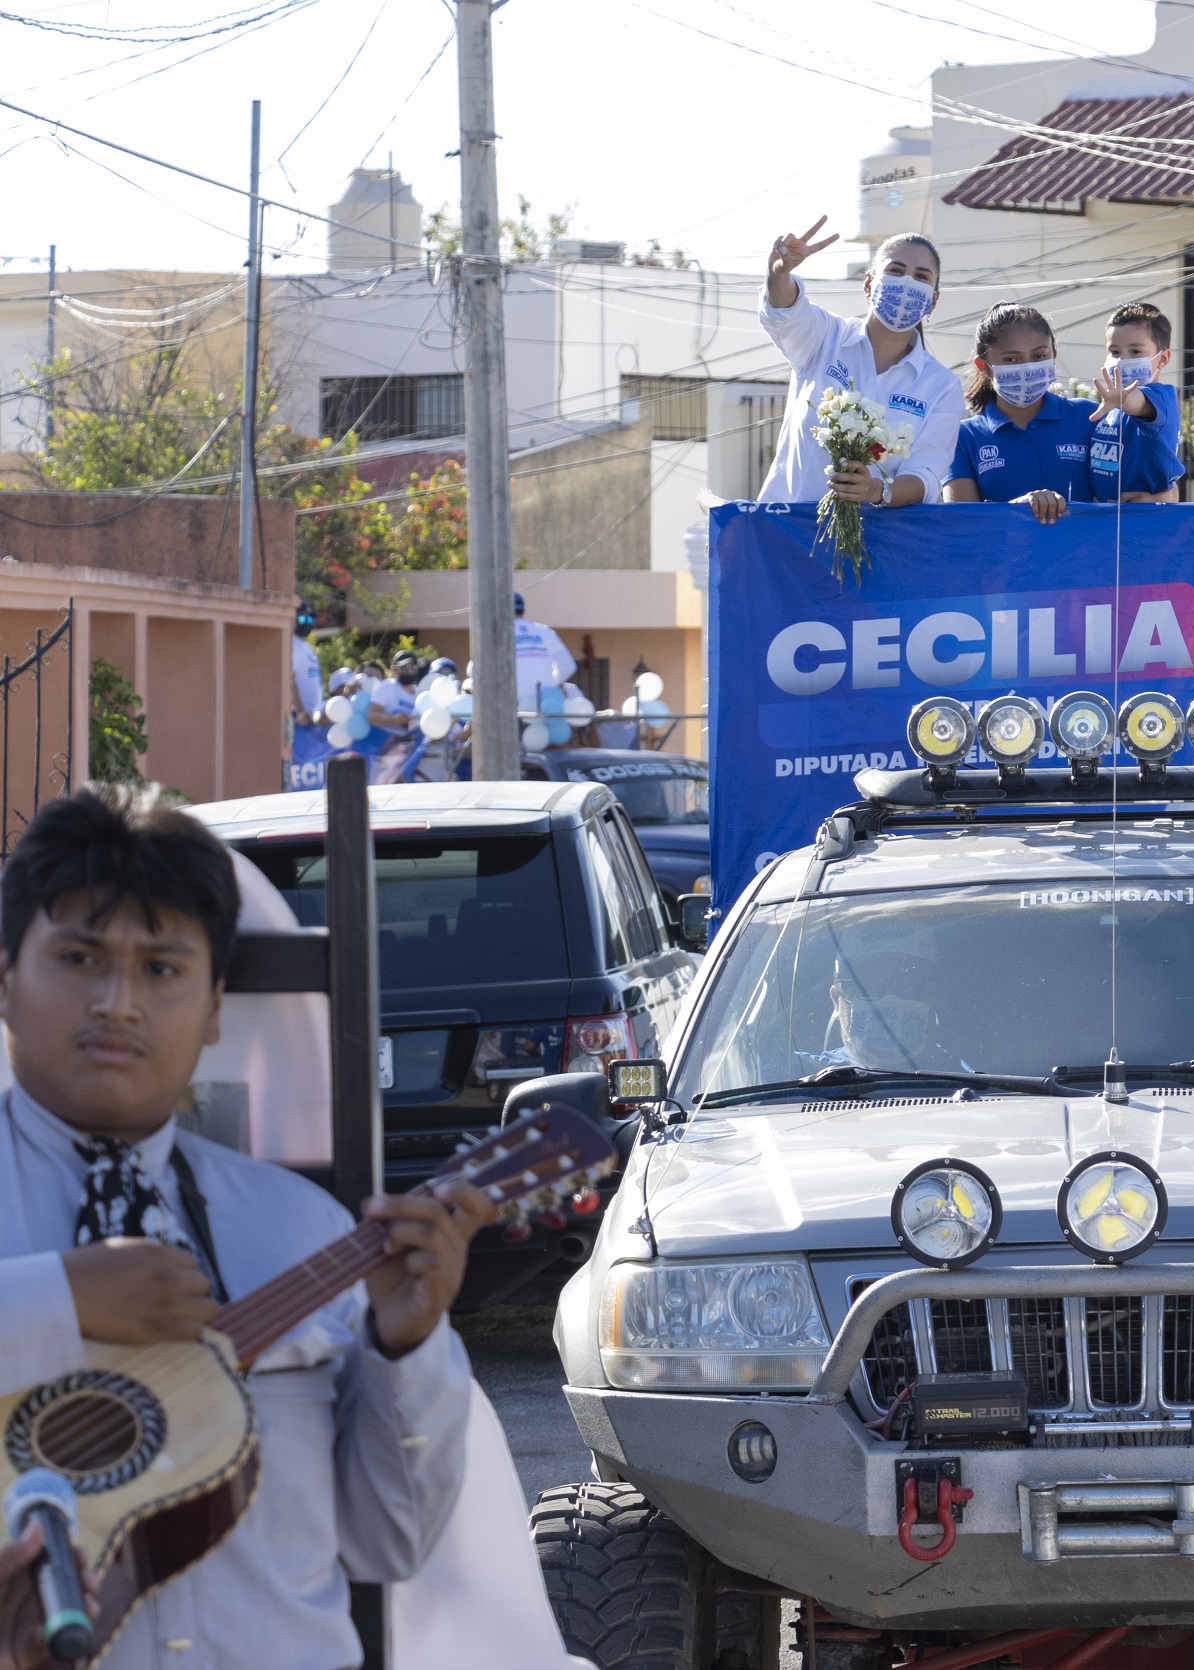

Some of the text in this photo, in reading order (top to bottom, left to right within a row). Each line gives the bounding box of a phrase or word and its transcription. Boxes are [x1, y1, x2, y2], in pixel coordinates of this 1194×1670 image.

[892, 395, 924, 410] KARLA
[982, 448, 996, 459] PAN
[1058, 444, 1087, 455] KARLA
[1090, 442, 1118, 462] RLA
[767, 600, 1193, 696] CECILIA
[591, 763, 674, 782] DODGE
[775, 750, 907, 777] DIPUTADA
